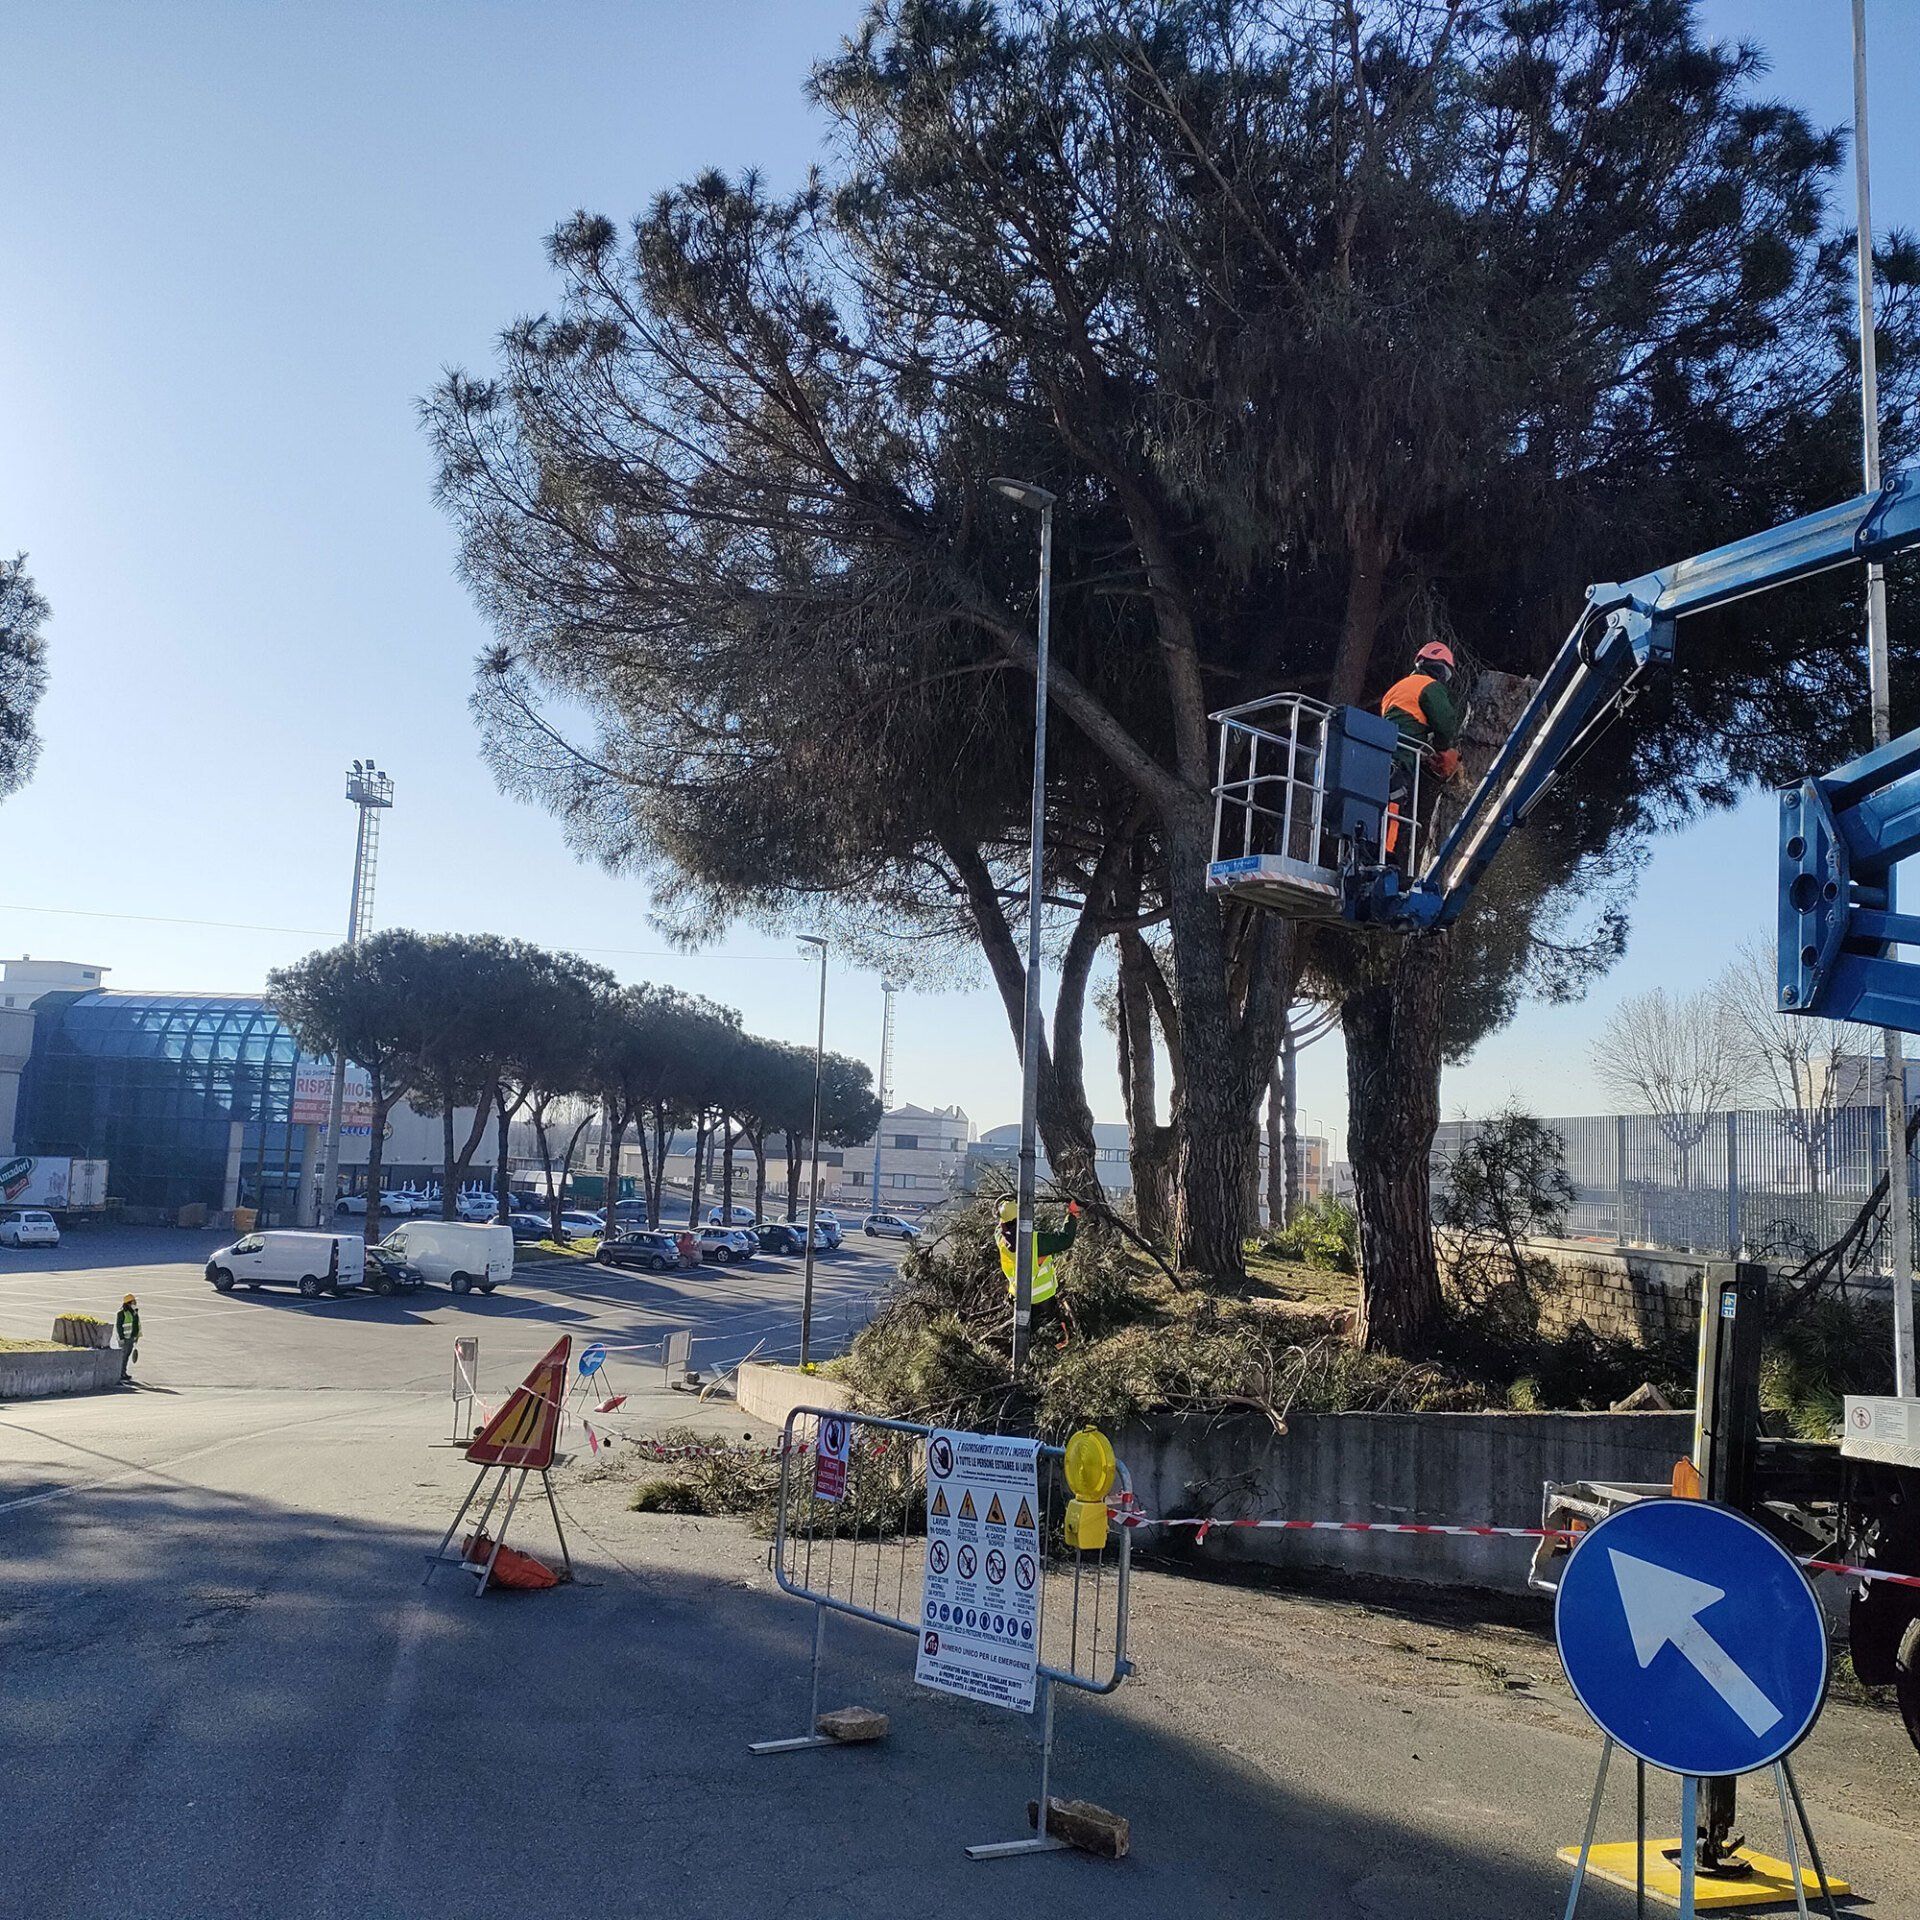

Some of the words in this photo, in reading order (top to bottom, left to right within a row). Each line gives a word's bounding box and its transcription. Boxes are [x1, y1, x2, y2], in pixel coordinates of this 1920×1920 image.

[296, 1078, 364, 1098] RISPAMIO
[993, 1445, 1010, 1456] VIETATO
[959, 1455, 972, 1466] TUTTE
[976, 1457, 995, 1469] PERSONE
[995, 1459, 1015, 1472] ESTRANEE
[1020, 1462, 1035, 1474] LAVORI
[932, 1517, 948, 1527] LAVORI
[958, 1521, 976, 1529] TENSIONE
[935, 1527, 951, 1537] CORSO
[958, 1528, 977, 1536] ELETTRICA
[985, 1525, 1007, 1534] ATTENZIONE
[1016, 1529, 1033, 1538] CADUTA
[990, 1533, 1005, 1541] CARICHI
[1014, 1537, 1036, 1546] MATERIALI
[942, 1642, 962, 1655] NUMERO
[963, 1647, 979, 1659] UNICO
[979, 1651, 990, 1661] PER
[998, 1655, 1031, 1671] EMERGENZE
[1017, 1697, 1031, 1707] LAVORO
